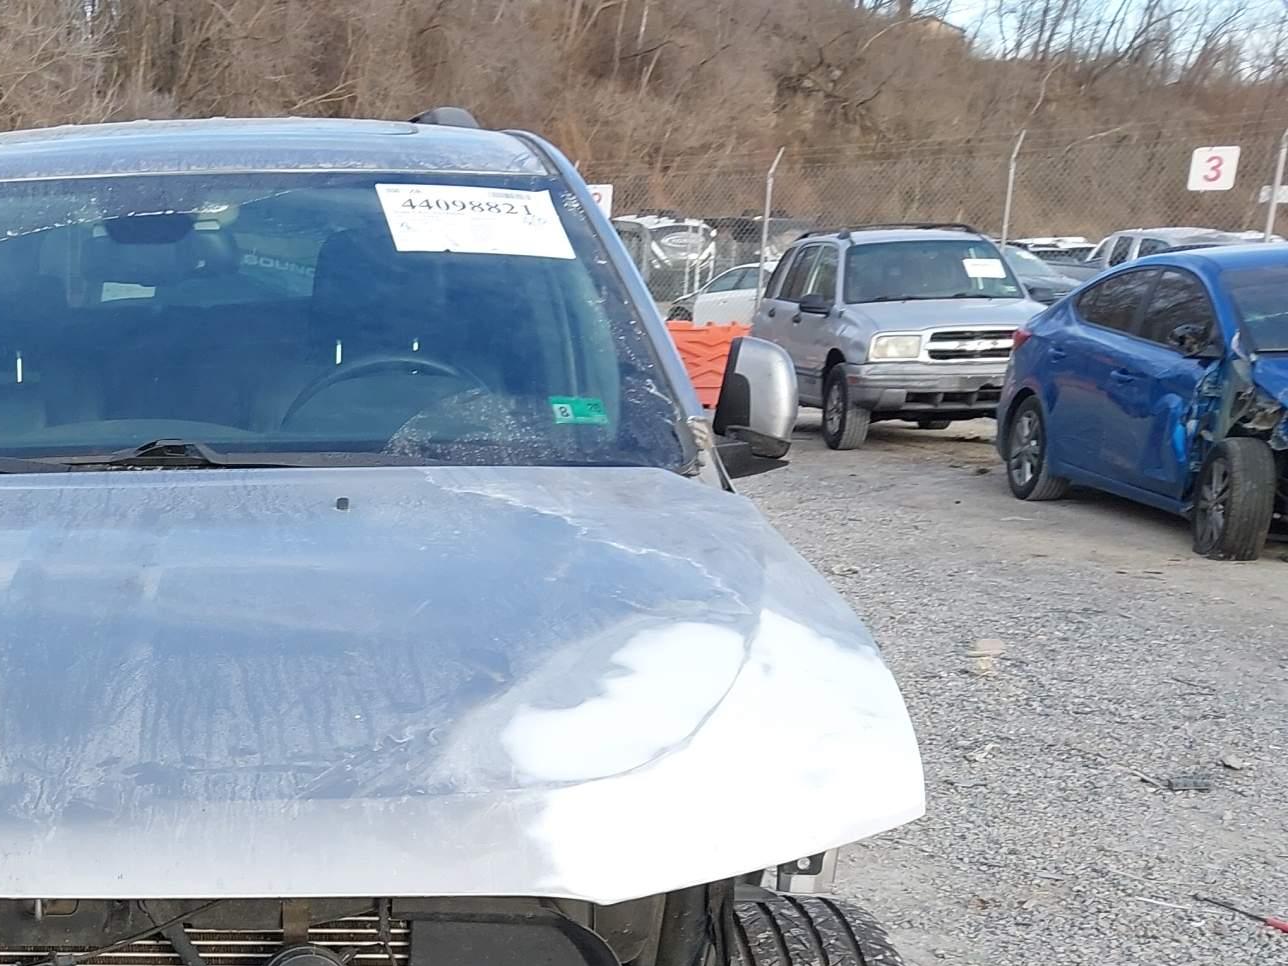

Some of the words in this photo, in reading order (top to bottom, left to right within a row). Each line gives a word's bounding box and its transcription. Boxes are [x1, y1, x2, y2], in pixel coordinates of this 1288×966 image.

[1202, 155, 1224, 183] 3
[400, 198, 533, 216] 44098821
[558, 406, 570, 417] 8
